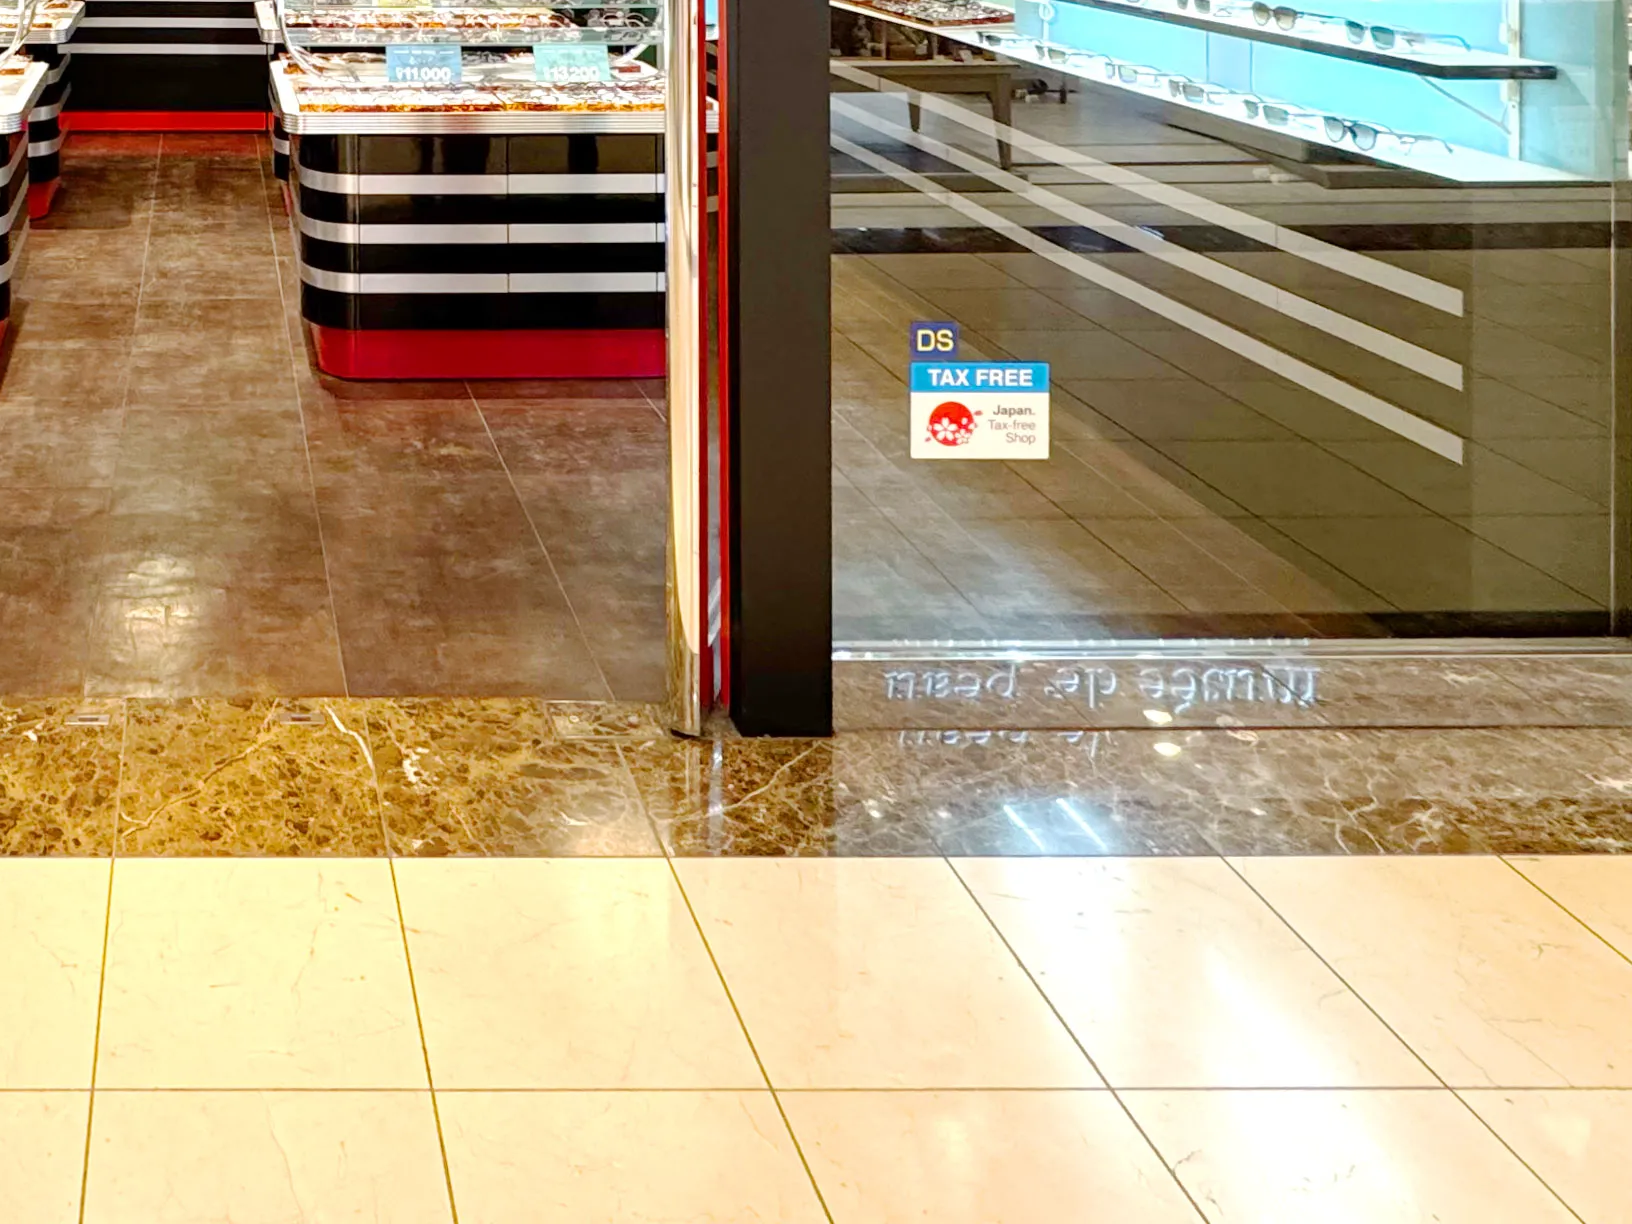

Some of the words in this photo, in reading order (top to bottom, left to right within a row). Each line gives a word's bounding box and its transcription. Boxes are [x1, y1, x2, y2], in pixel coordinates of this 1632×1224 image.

[915, 328, 955, 352] DS
[927, 368, 970, 387] TAX
[975, 368, 1034, 387] FREE
[992, 404, 1036, 418] Japan.
[987, 419, 1037, 431] Tax-free
[1005, 432, 1037, 445] Shop
